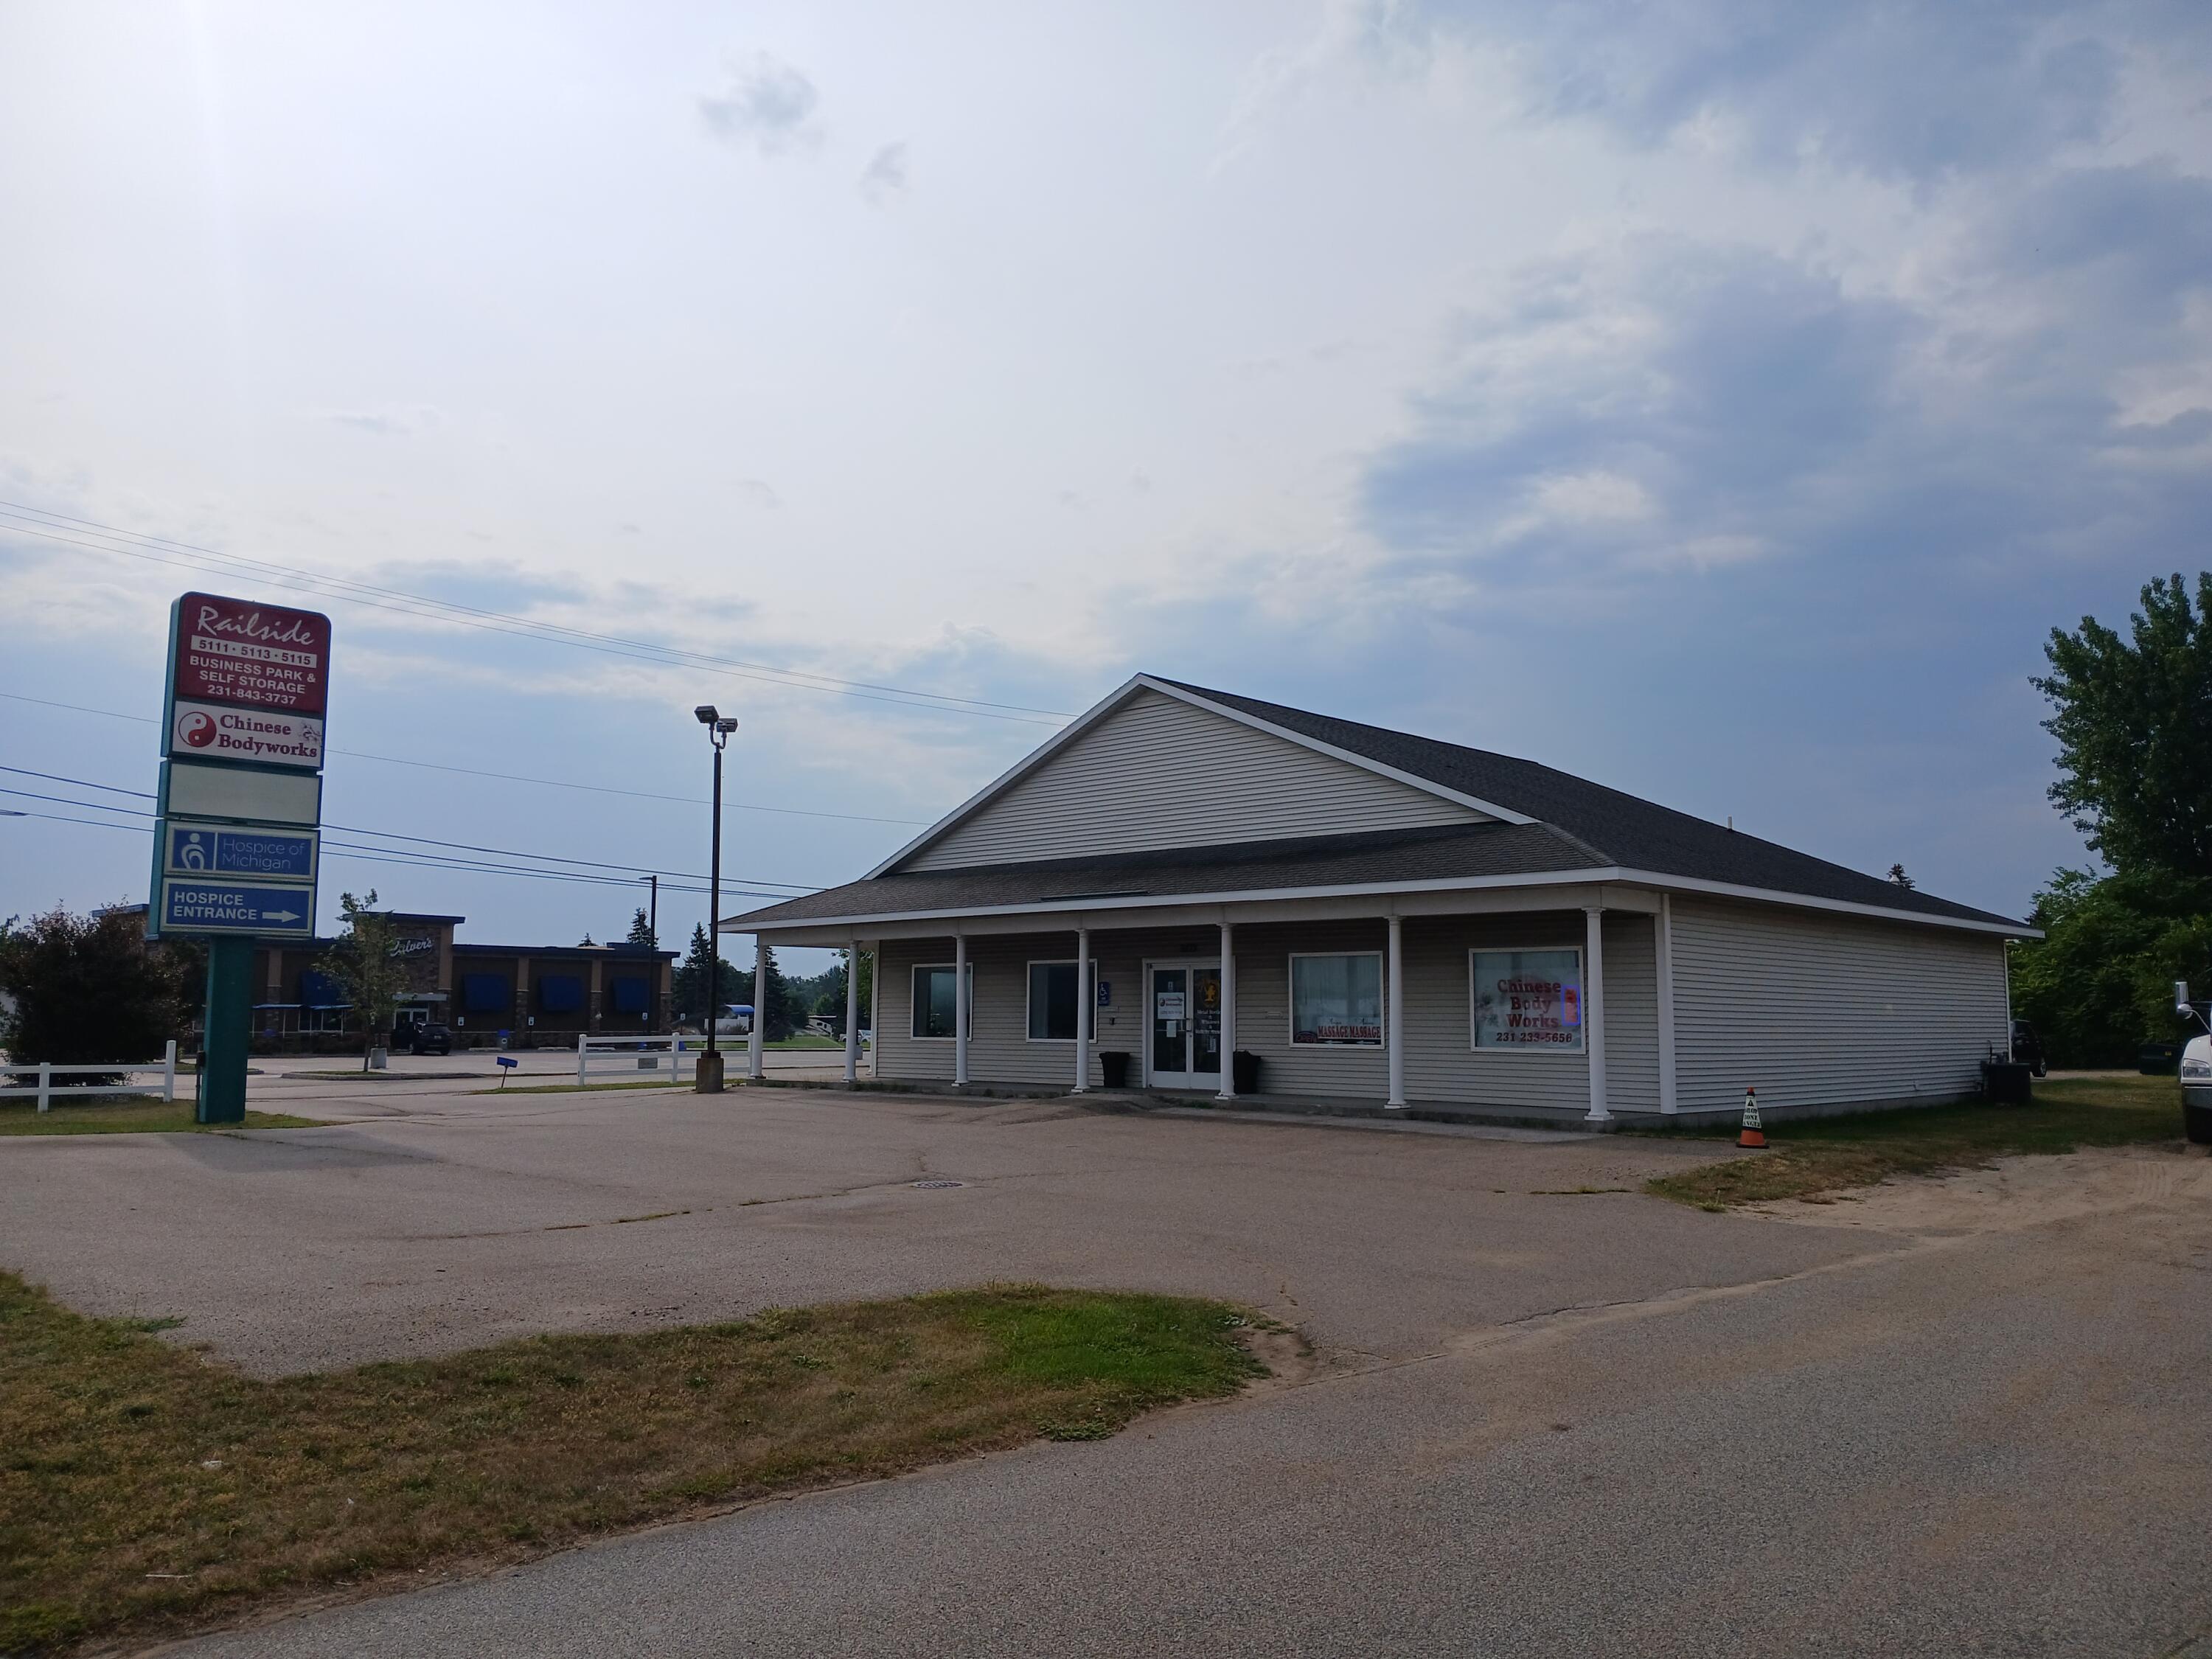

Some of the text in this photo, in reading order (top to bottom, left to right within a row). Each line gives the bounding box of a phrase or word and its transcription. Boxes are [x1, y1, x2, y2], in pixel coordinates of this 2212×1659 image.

[198, 605, 315, 646] Railside
[199, 639, 311, 666] 5111 5113 5115
[189, 655, 316, 684] BUSINESS PARK &
[199, 670, 307, 695] SELF STORAGE
[207, 685, 297, 706] 231-843-3737
[220, 714, 292, 736] Chinese
[218, 734, 318, 758] Bodyworks
[223, 838, 305, 855] Hospice of
[222, 853, 291, 872] Michigan
[174, 891, 244, 906] HOSPICE
[173, 906, 257, 920] ENTRANCE
[1498, 978, 1561, 993] Chinese
[1510, 996, 1551, 1014] Body
[1506, 1014, 1559, 1028] Works
[1318, 1026, 1381, 1038] MASSAGE MASSAGE
[1496, 1032, 1515, 1042] 231
